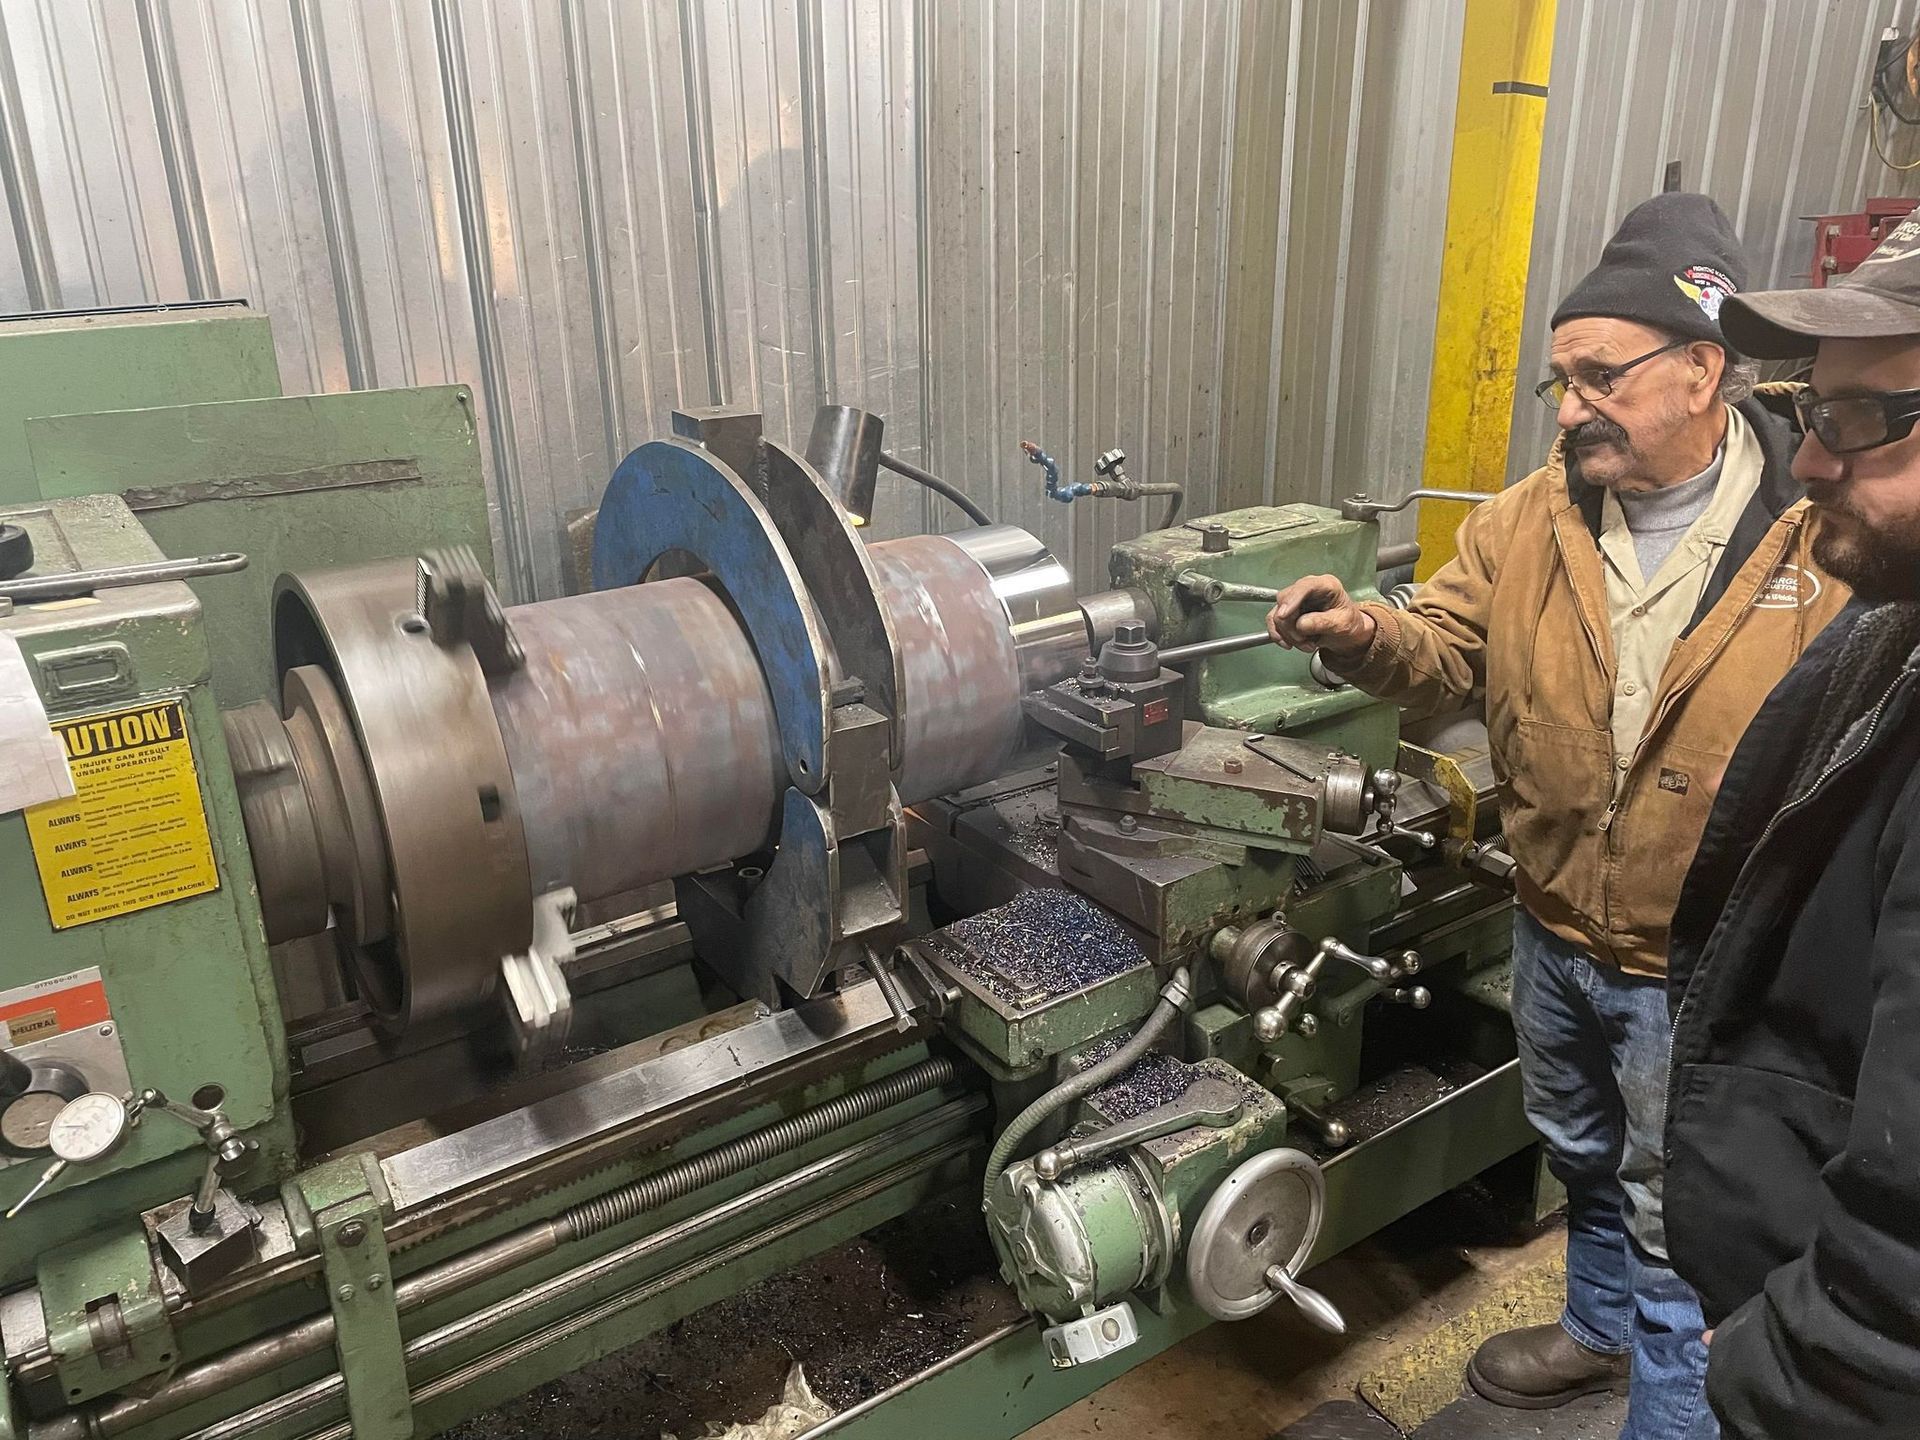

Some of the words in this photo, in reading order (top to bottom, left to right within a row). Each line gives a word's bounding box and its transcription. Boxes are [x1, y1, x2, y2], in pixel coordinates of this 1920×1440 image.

[53, 707, 171, 757] UTION
[76, 766, 111, 778] UNSAFE
[115, 754, 163, 770] OPERATION
[80, 758, 112, 770] INJURY
[117, 754, 134, 762] CAN
[138, 746, 170, 757] RESULT
[48, 814, 81, 828] ALWAYS
[54, 839, 87, 853] ALWAYS
[61, 864, 93, 878] ALWAYS
[67, 889, 99, 903] ALWAYS
[93, 902, 121, 913] REMOVE
[177, 881, 206, 892] MACHINE
[12, 1019, 57, 1036] NEUTRAL
